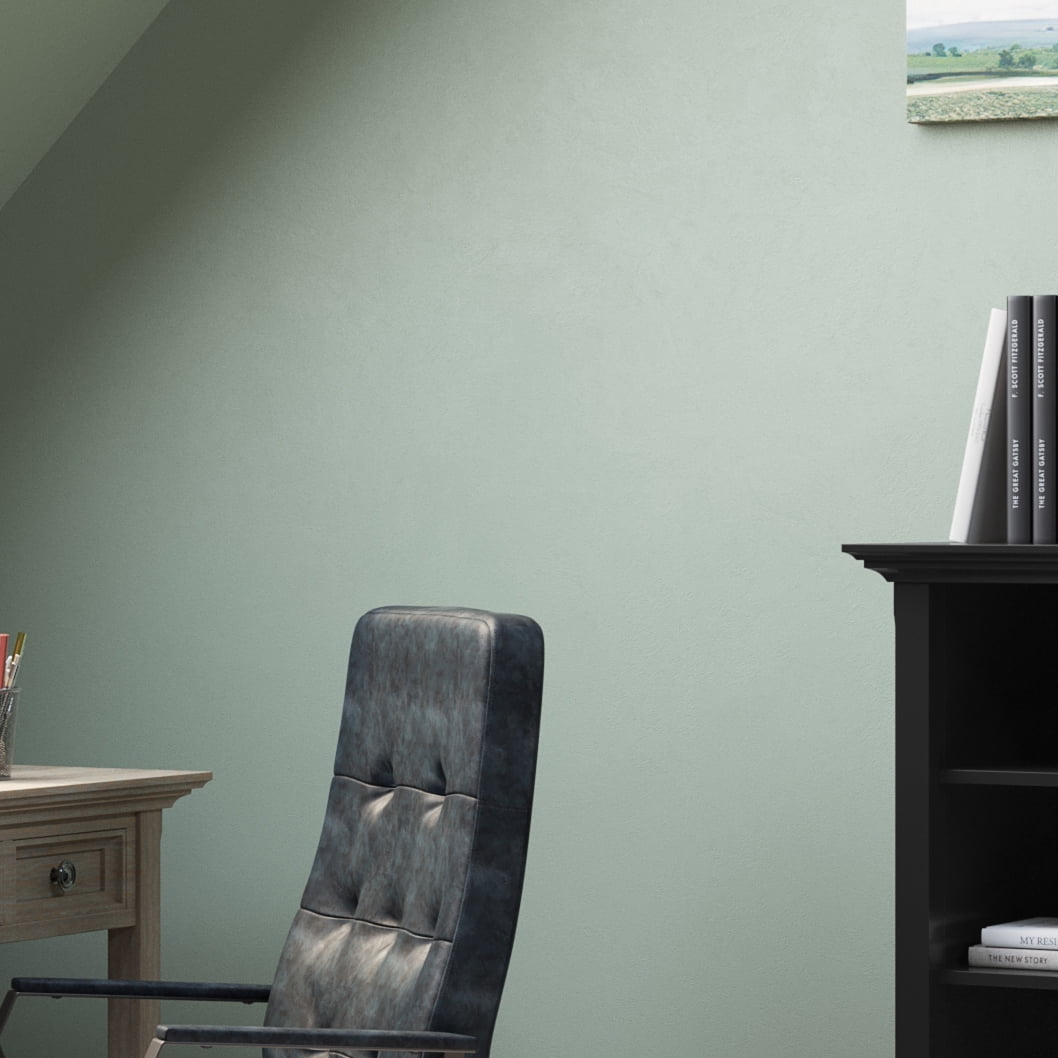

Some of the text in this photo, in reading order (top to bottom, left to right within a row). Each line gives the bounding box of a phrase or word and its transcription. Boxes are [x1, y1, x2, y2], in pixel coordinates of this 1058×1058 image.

[1020, 936, 1035, 946] MY
[988, 954, 1002, 963] THE
[1005, 955, 1022, 964] NEW
[1024, 956, 1048, 965] STORY
